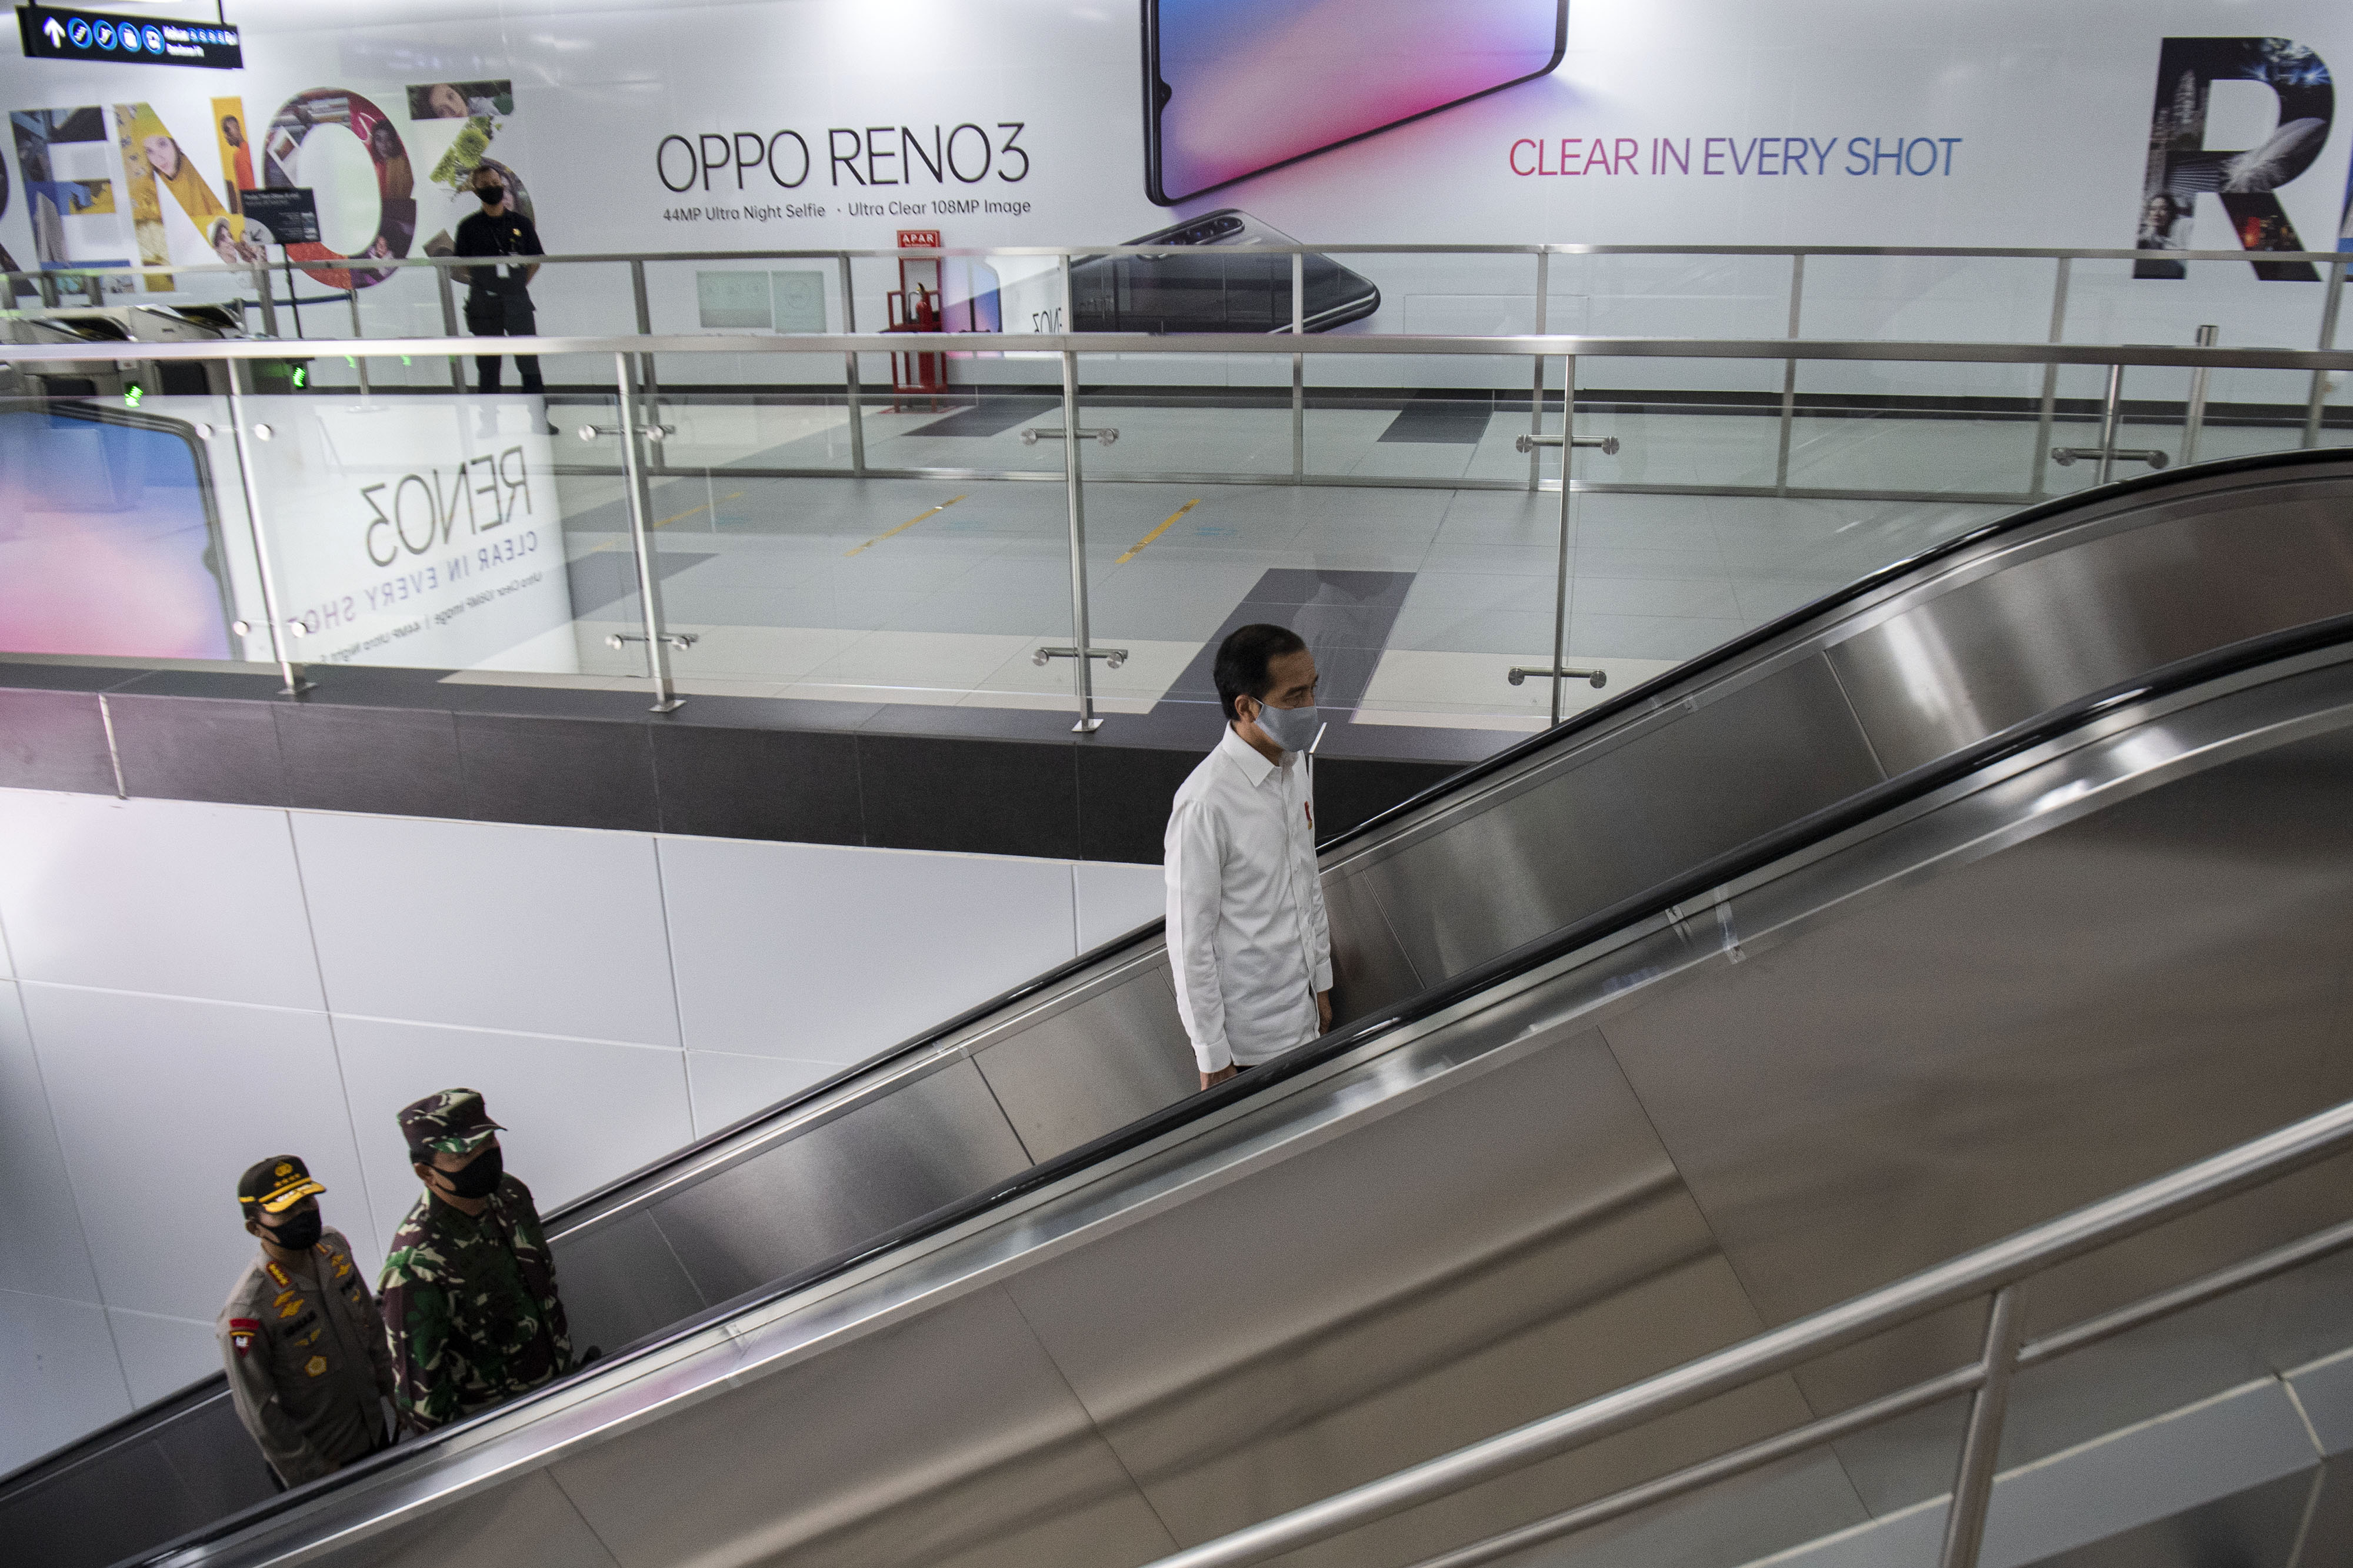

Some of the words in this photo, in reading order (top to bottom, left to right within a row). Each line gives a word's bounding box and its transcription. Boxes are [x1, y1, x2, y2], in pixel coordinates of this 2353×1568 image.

[656, 129, 810, 192] OPPO
[828, 122, 1029, 186] RENO3
[1509, 138, 1639, 176] CLEAR
[1651, 138, 1691, 175] IN
[1703, 137, 1838, 176] EVERY
[1845, 136, 1963, 176] SHOT
[663, 207, 701, 221] 44MP
[706, 206, 739, 221] Ultra
[744, 205, 781, 222] Night
[785, 202, 825, 218] Selfie
[848, 202, 884, 216] Ultra
[888, 201, 926, 215] Clear
[931, 199, 979, 213] 108MP
[984, 199, 1031, 216] Image
[902, 233, 934, 243] APAR
